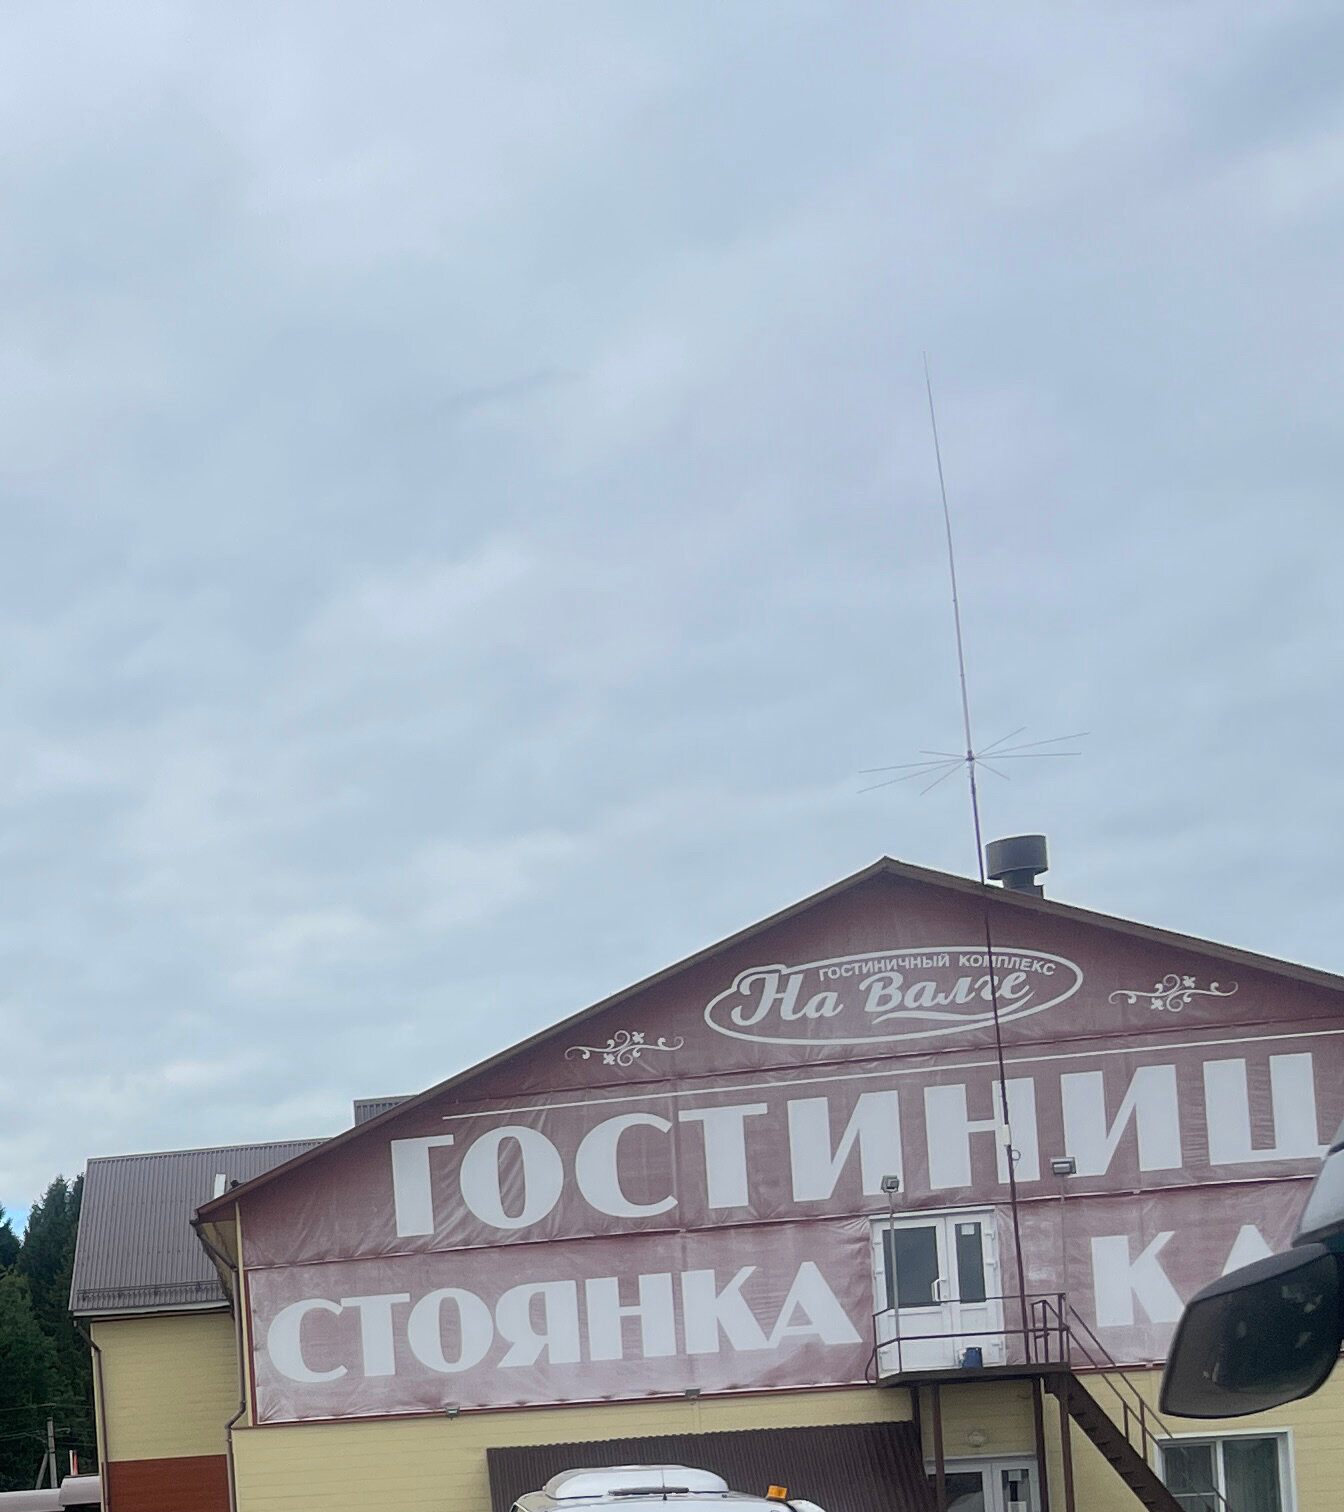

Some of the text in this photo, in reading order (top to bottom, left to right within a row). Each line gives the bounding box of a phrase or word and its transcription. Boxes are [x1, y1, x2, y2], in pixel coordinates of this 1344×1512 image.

[818, 952, 1056, 981] ГОСТИНИЧНЫЙ КОМПЛЕКС
[730, 970, 1034, 1026] На Валге
[267, 1261, 863, 1383] СТОЯНКА
